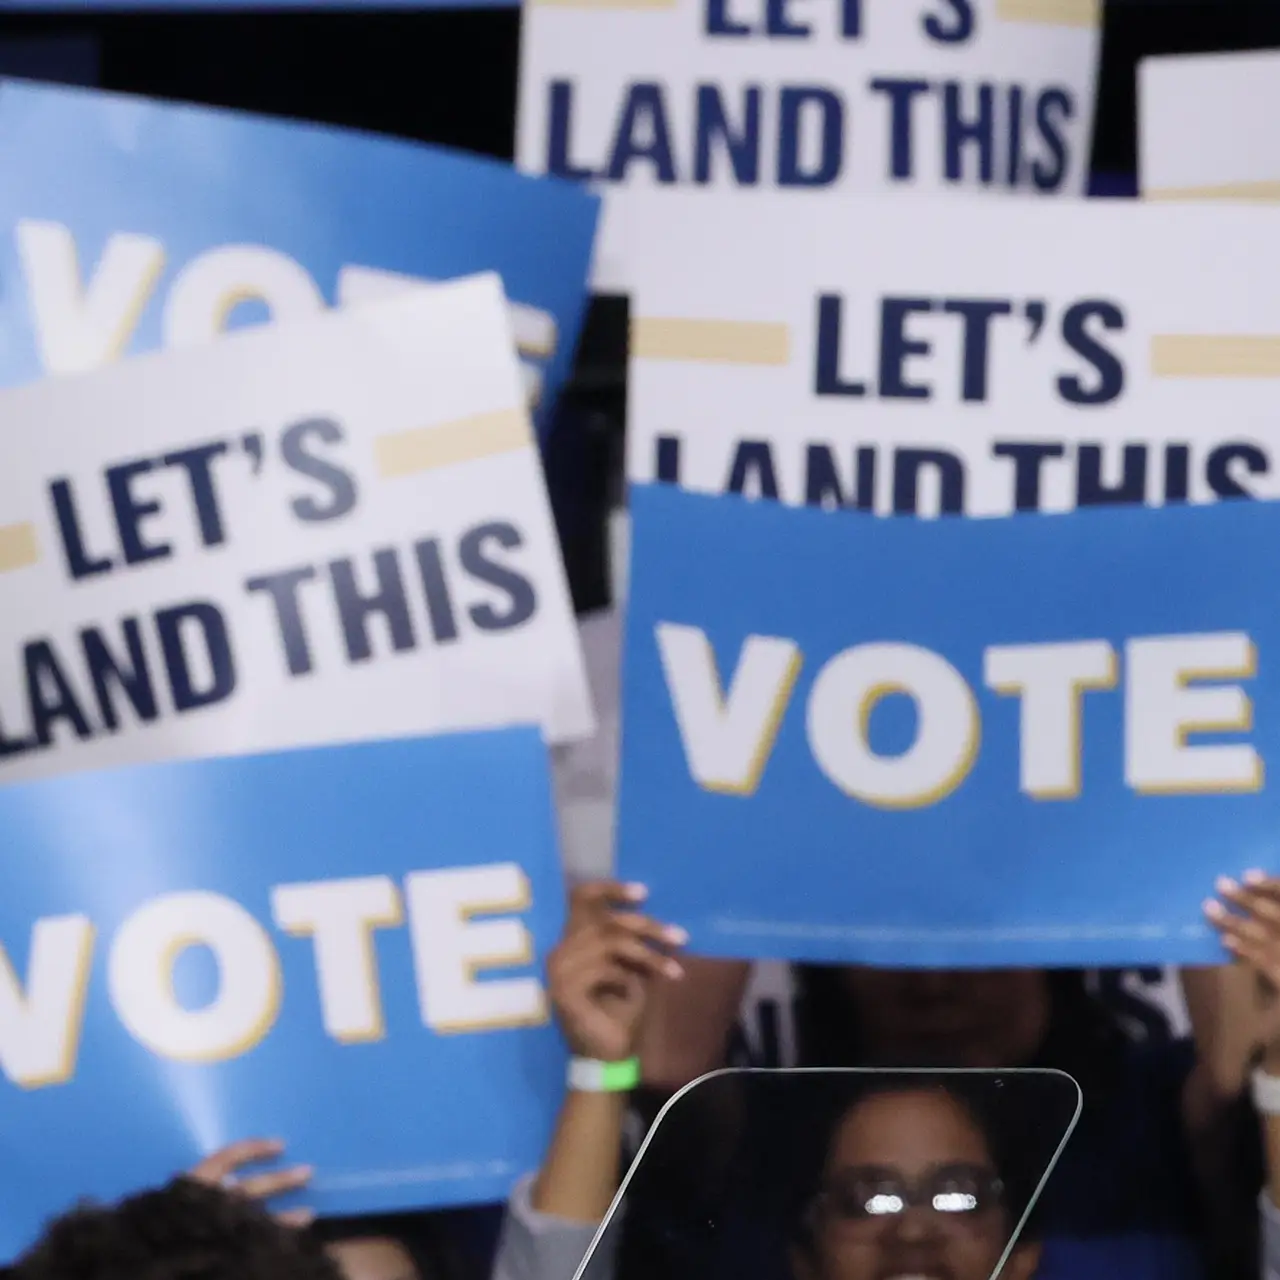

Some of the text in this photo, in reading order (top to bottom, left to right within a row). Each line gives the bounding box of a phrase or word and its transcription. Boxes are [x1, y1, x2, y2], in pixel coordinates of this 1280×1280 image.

[544, 78, 1076, 195] LAND THIS
[813, 293, 1127, 406] LET'S
[49, 416, 359, 581] LET'S
[245, 520, 538, 677] THIS
[655, 621, 1264, 809] VOTE
